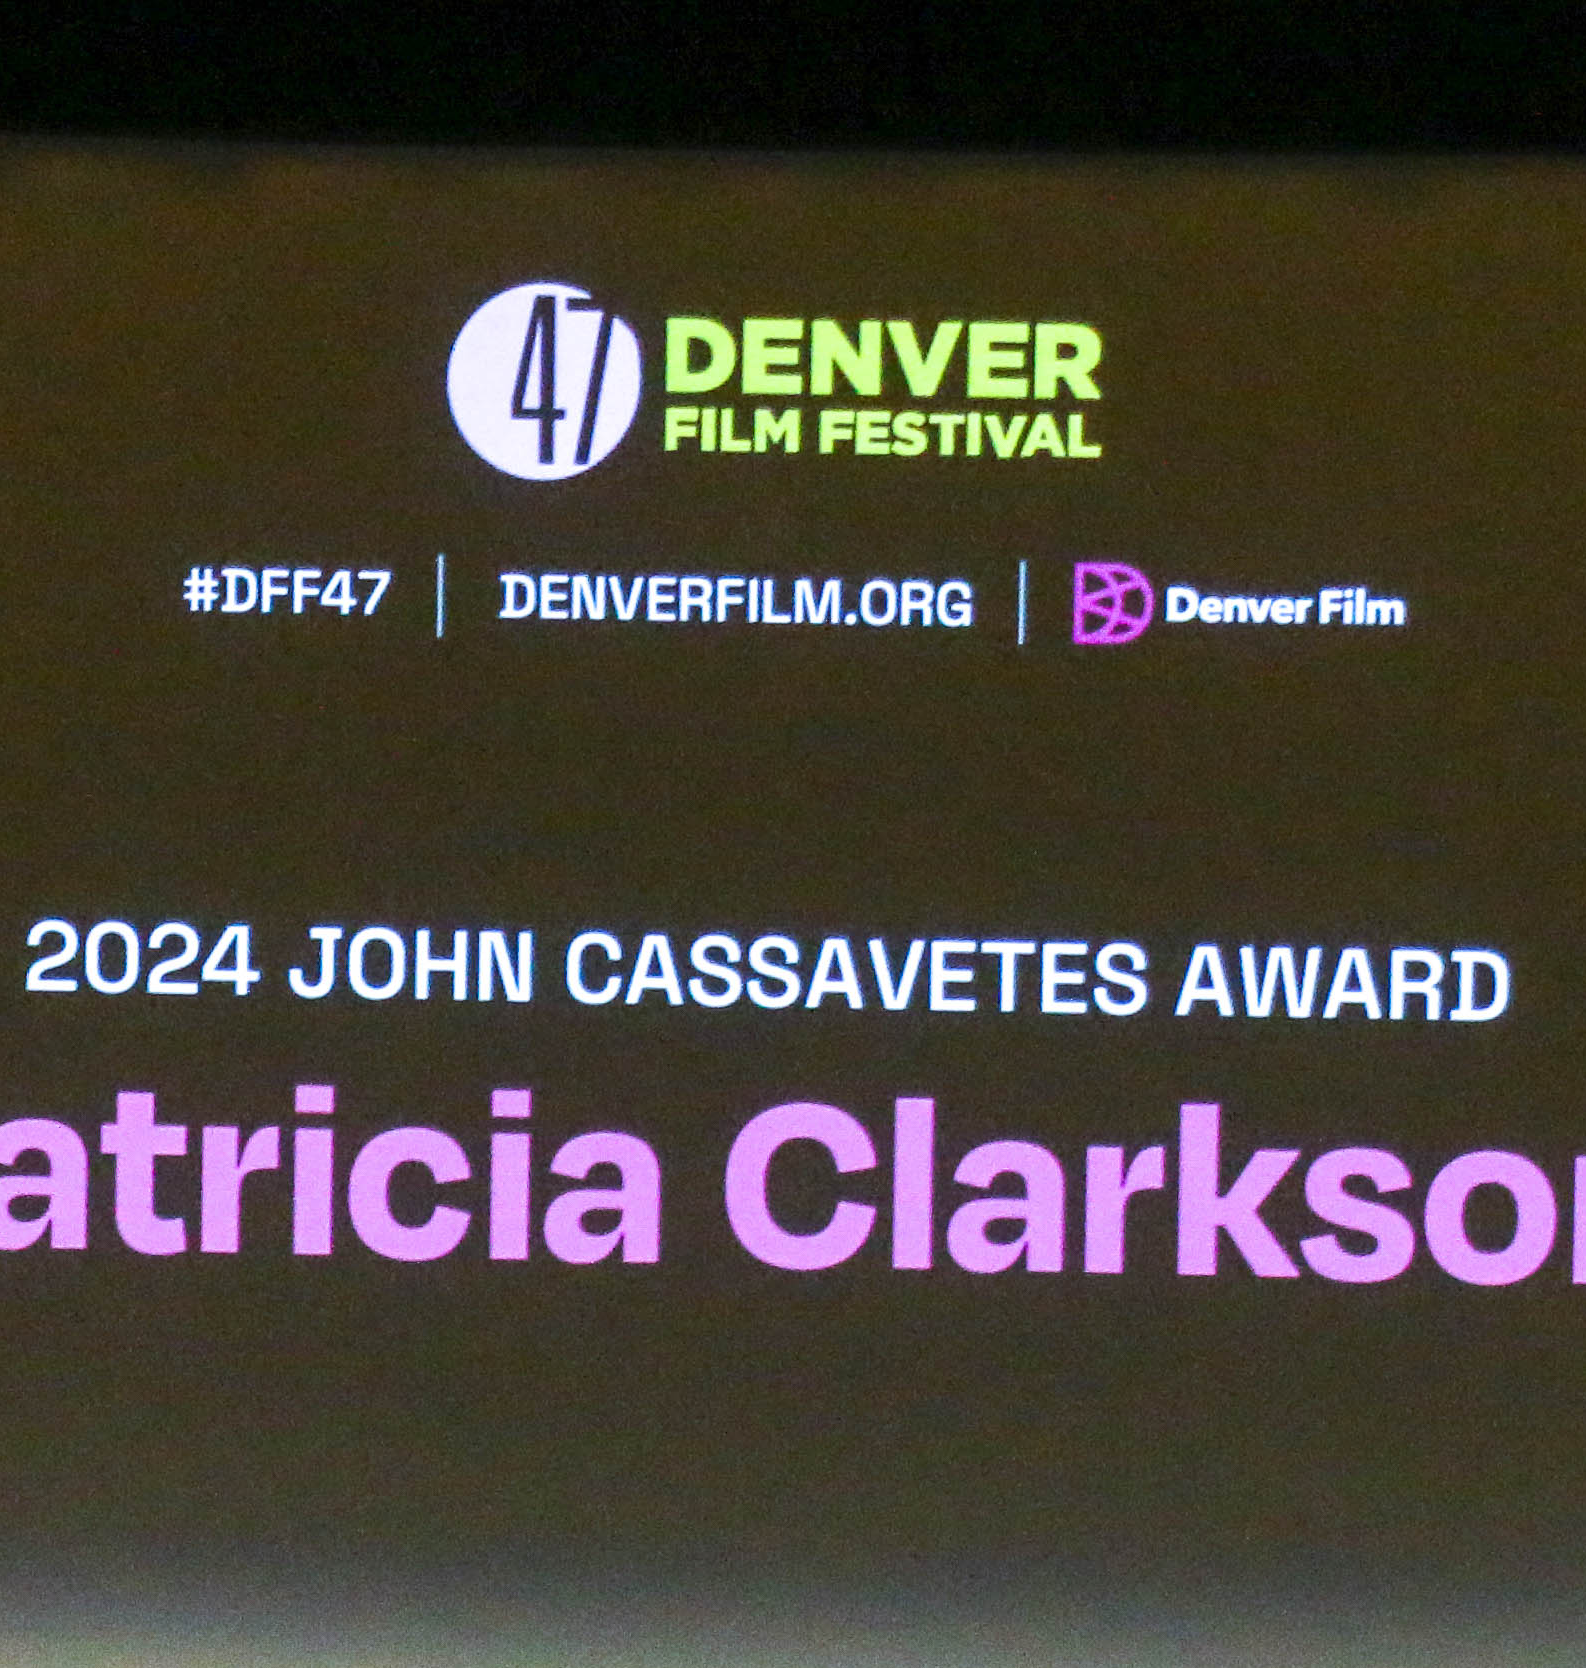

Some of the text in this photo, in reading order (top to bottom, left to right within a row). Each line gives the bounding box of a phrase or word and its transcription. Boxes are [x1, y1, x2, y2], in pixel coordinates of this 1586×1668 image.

[511, 295, 614, 464] 47
[665, 315, 1103, 402] DENVER
[665, 405, 1103, 460] FILM FESTIVAL
[182, 564, 394, 617] #DFF47
[497, 569, 975, 628] DENVERFILM.ORG
[1164, 584, 1408, 627] Denver Film
[24, 916, 1512, 1023] 2024 JOHN CASSAVETES AWARD
